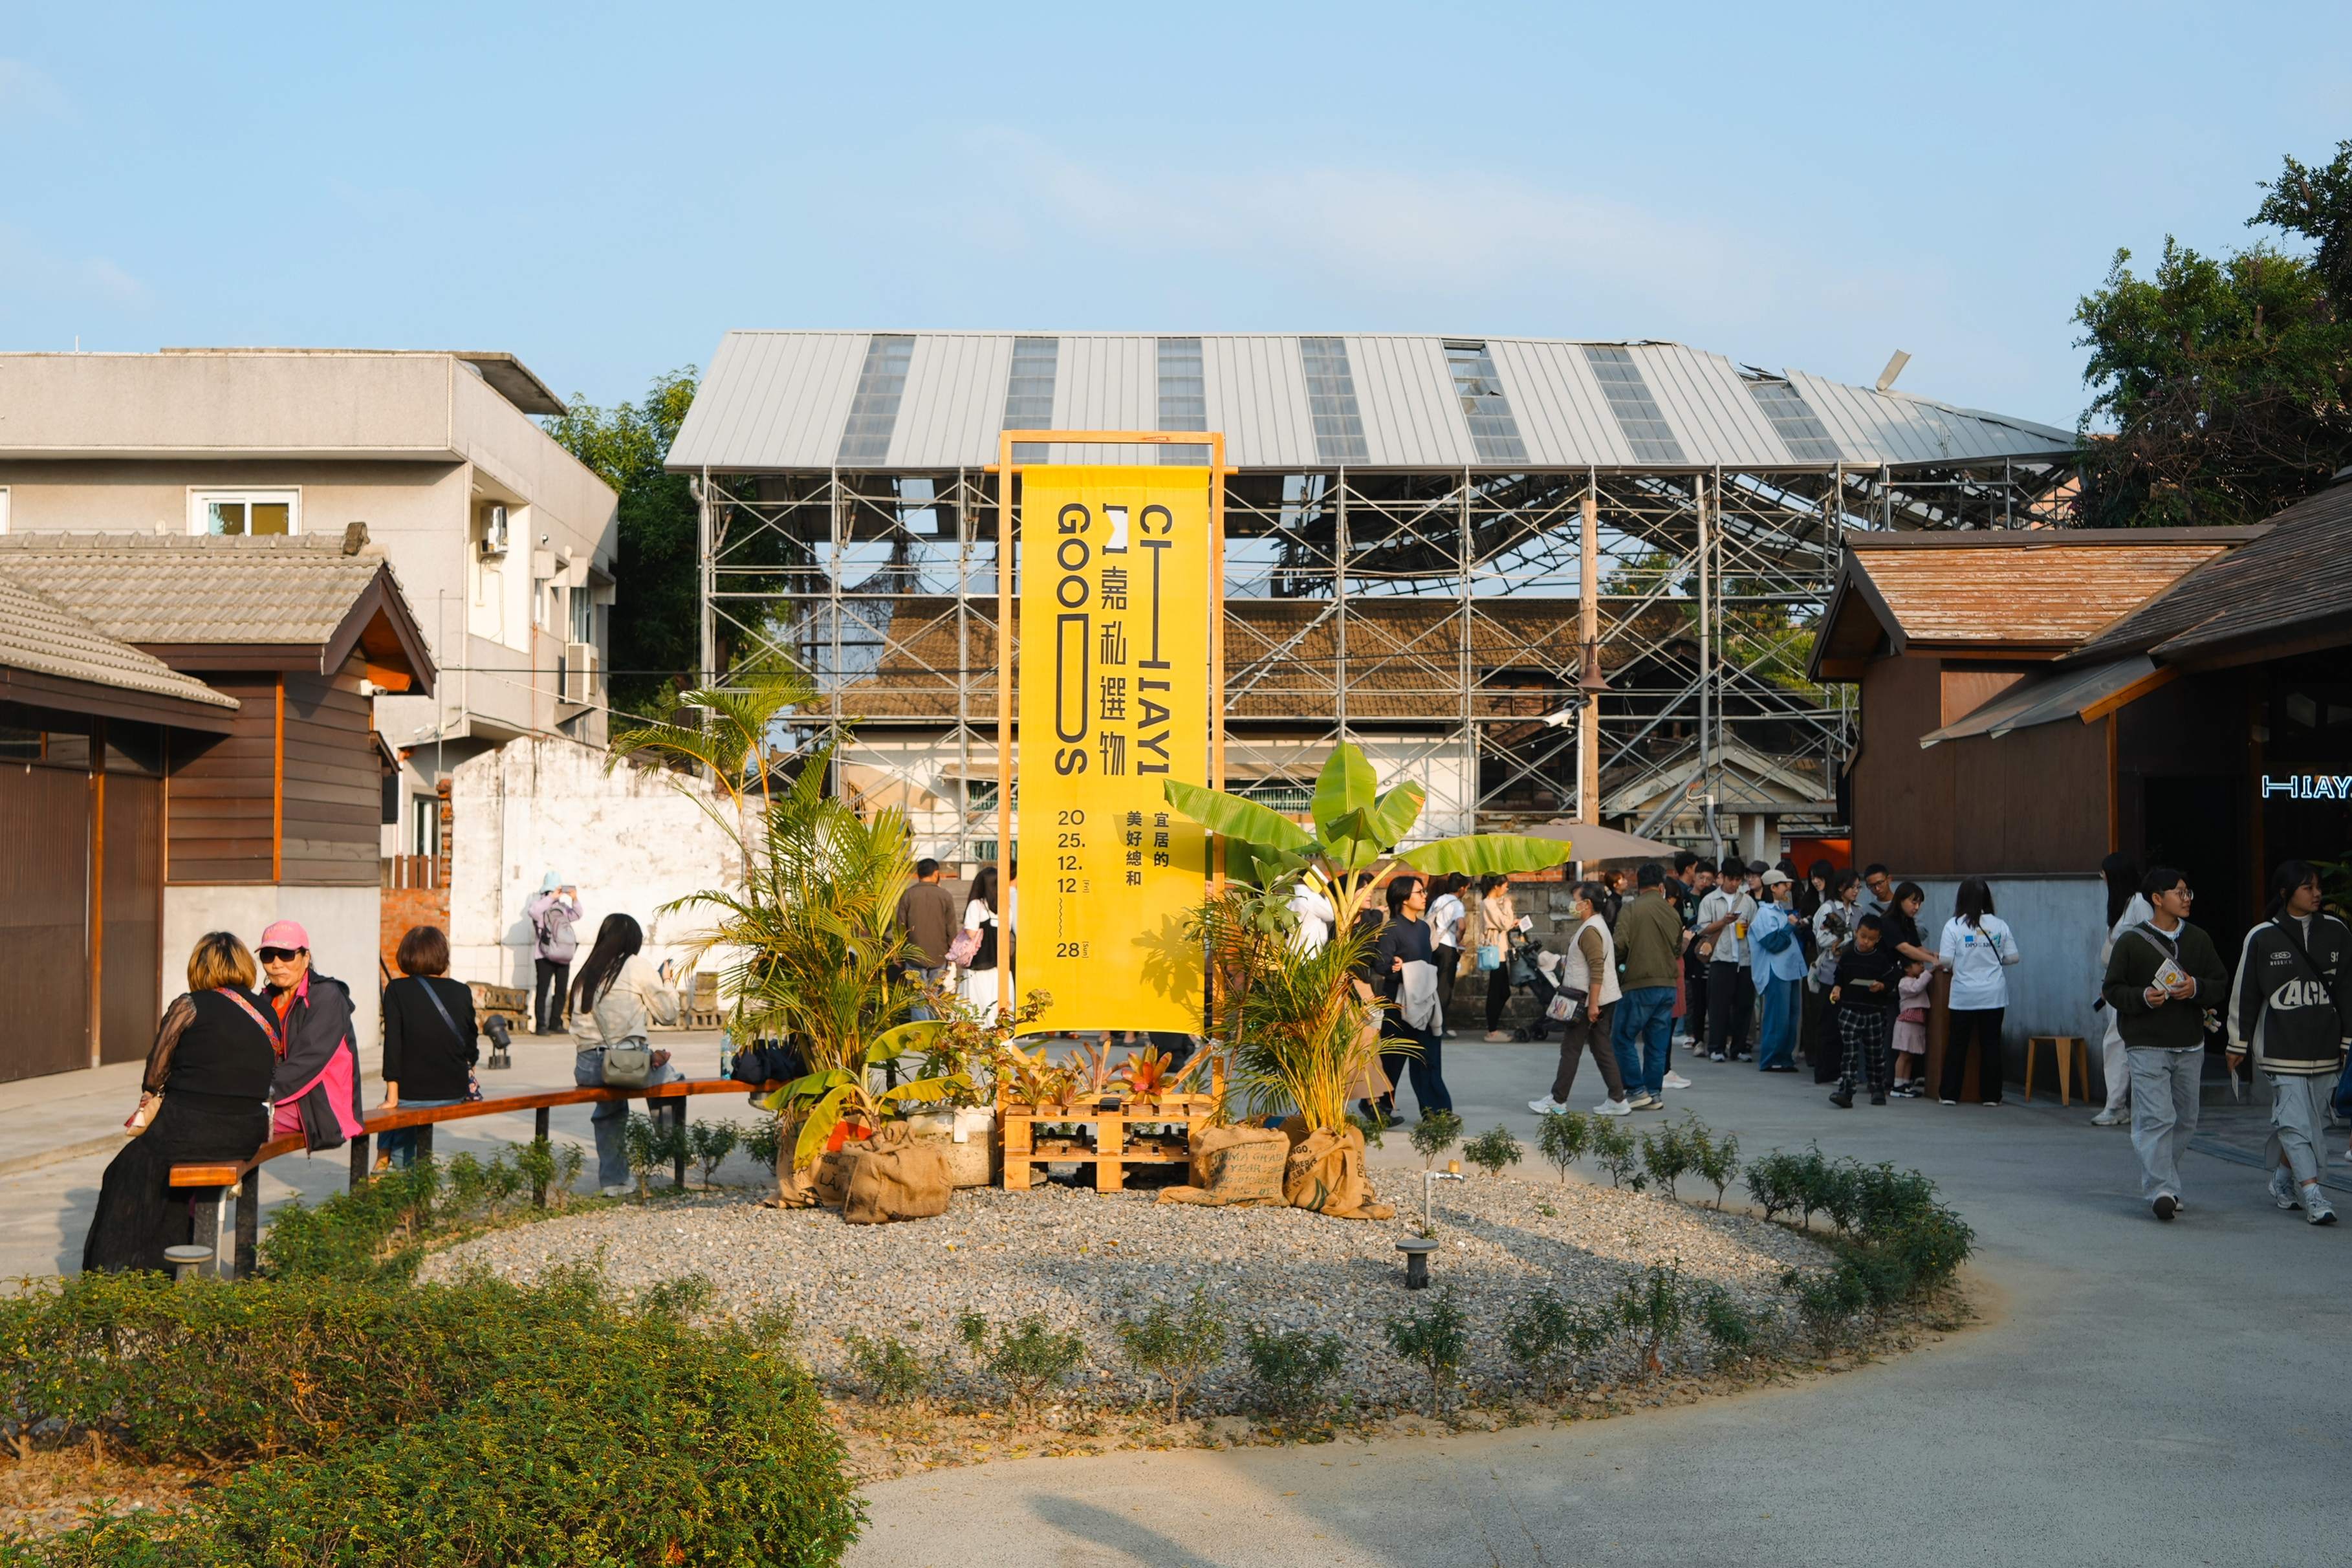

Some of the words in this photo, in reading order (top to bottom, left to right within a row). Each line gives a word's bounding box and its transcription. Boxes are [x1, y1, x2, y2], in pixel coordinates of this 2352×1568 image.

[1055, 503, 1091, 776] GOODS
[1137, 504, 1173, 776] CHIAYI
[1099, 565, 1127, 776] 嘉私選物
[2261, 775, 2352, 799] HIAY
[1058, 809, 1085, 825] 20
[1057, 833, 1085, 848] 25.
[1126, 811, 1142, 886] 美好總和
[1153, 812, 1170, 867] 宜居的
[1057, 855, 1082, 871] 12.
[1057, 878, 1076, 893] 12
[1056, 942, 1080, 958] 28
